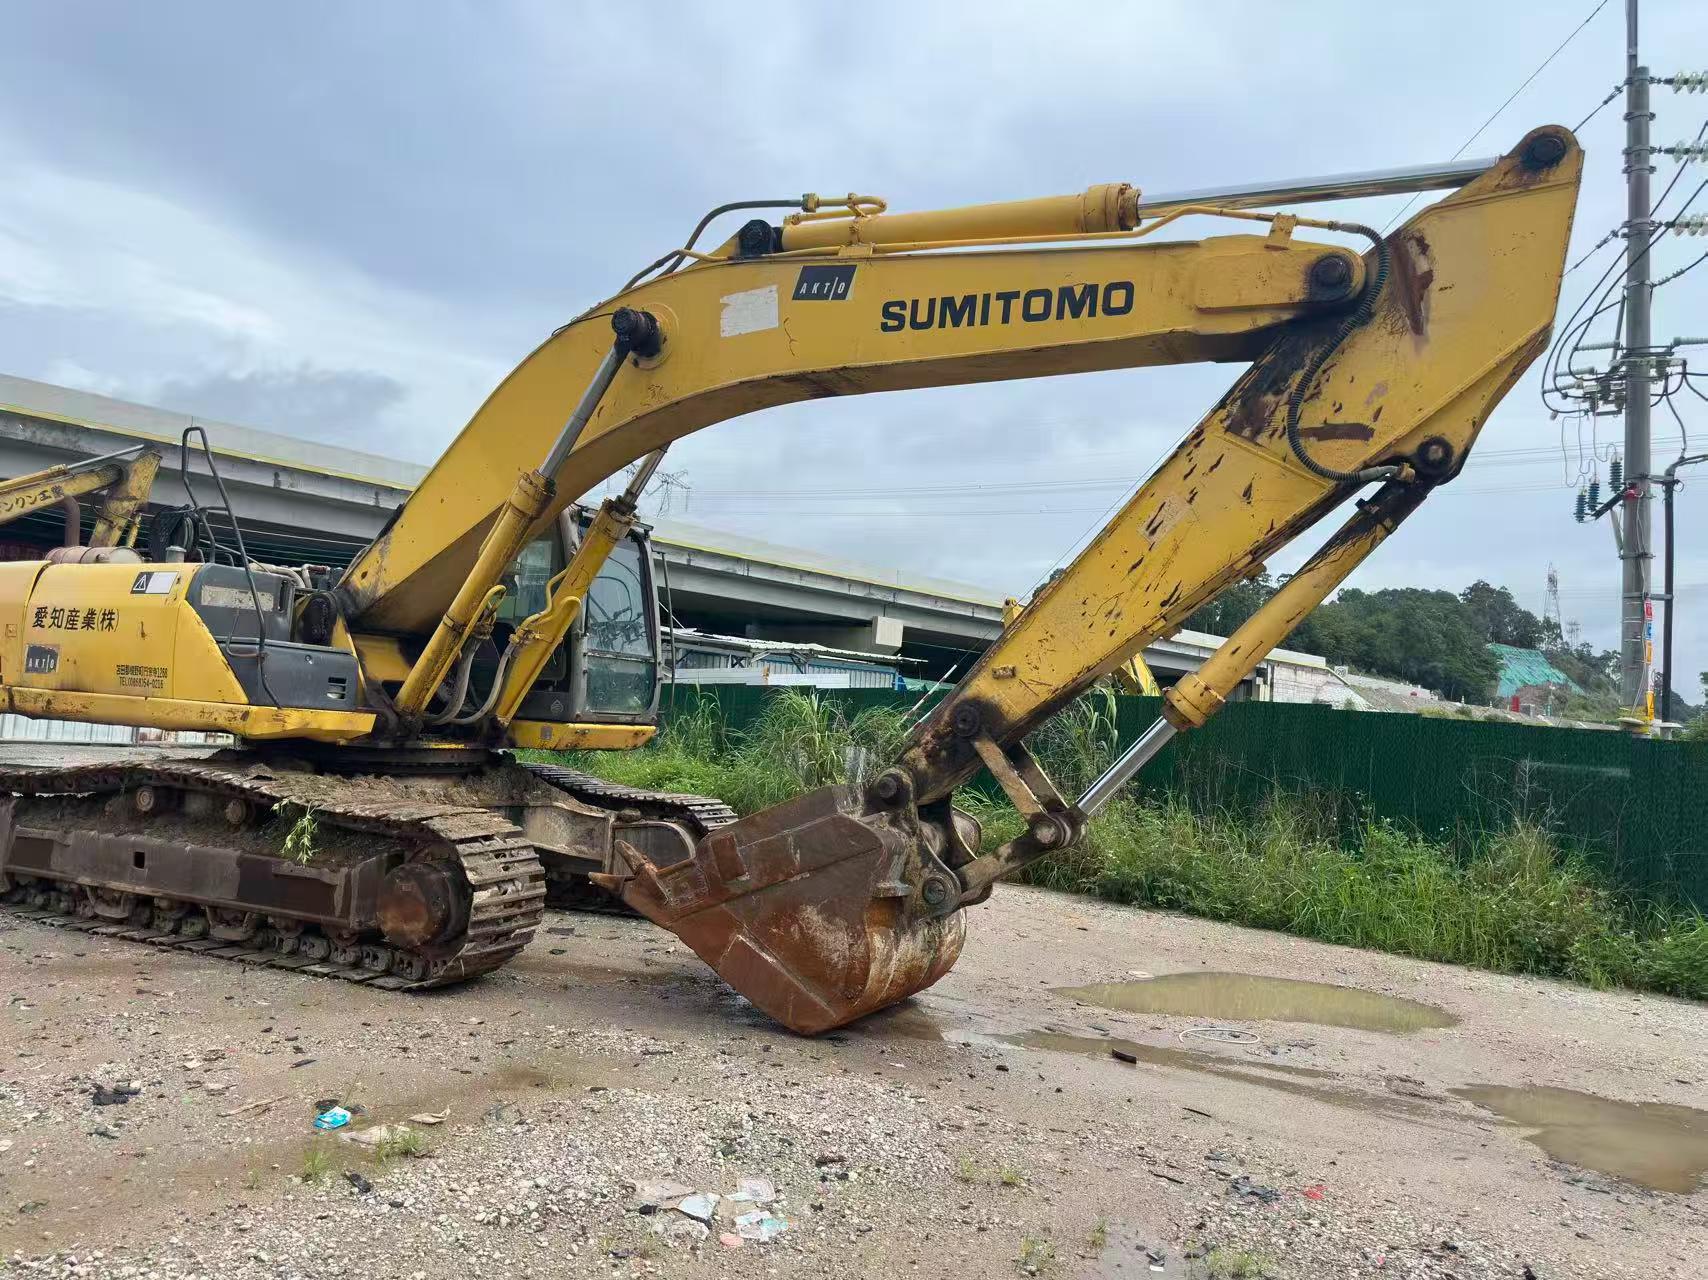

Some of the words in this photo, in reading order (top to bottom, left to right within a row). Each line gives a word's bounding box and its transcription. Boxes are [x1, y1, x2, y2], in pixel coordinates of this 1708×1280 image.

[880, 281, 1135, 332] SUMITOMO
[32, 606, 120, 633] 愛知産業(株)
